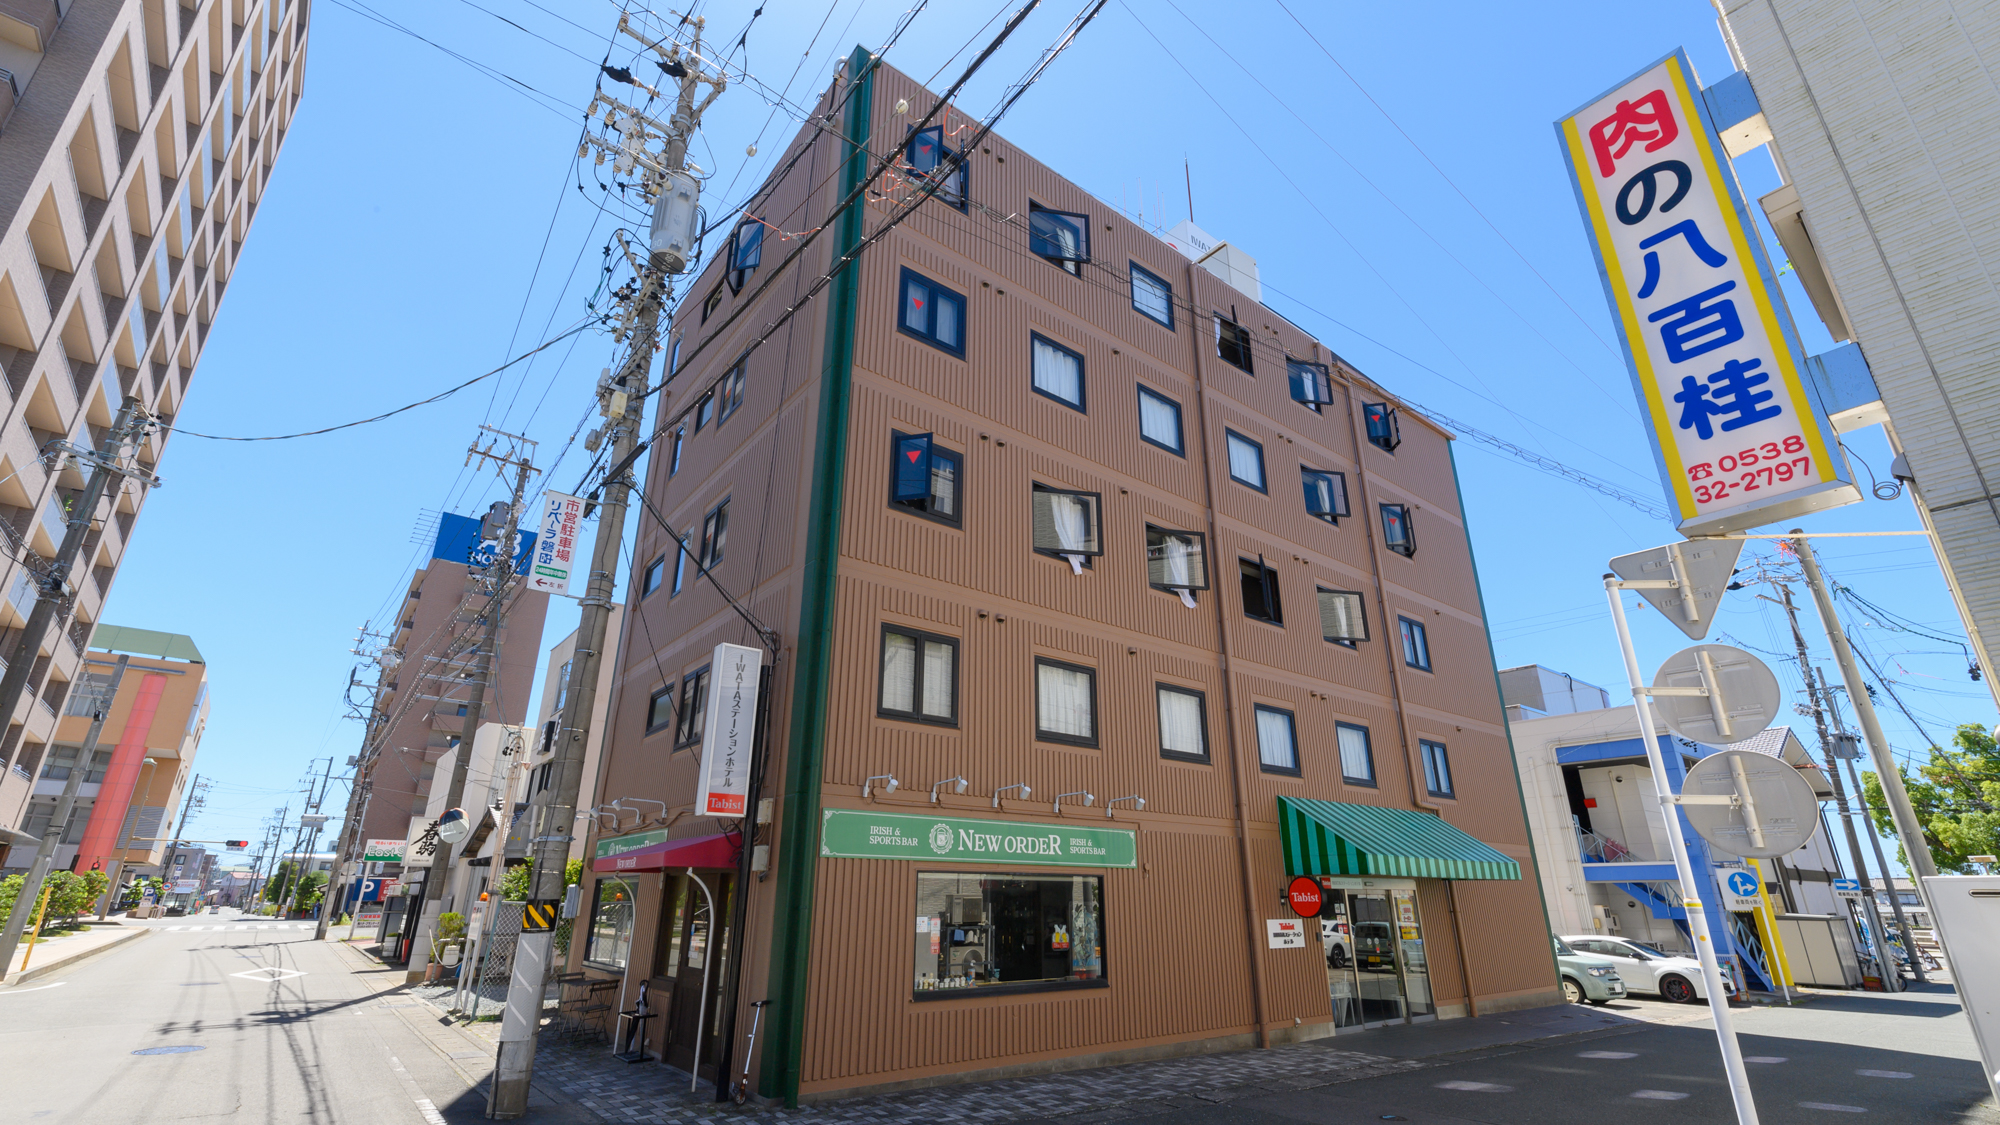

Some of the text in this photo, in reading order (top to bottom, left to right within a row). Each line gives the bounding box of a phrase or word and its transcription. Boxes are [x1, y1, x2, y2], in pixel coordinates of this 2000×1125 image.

[1589, 89, 1782, 441] 肉の八百桂
[1718, 435, 1805, 473] 0538
[1694, 456, 1810, 504] 32-2797
[538, 500, 562, 565] リベーラ磐田
[555, 499, 581, 563] 市営駐車場
[722, 653, 746, 788] IWATAステーションホテル
[709, 797, 742, 810] Tabist
[870, 825, 901, 836] IRISH &
[869, 835, 918, 847] SPORTS BAR
[958, 829, 1062, 856] NEW ORDER
[1069, 837, 1093, 847] IRISH &
[367, 845, 396, 857] East
[1069, 846, 1106, 856] SPORTS BAR
[144, 888, 154, 896] P
[362, 881, 375, 893] P
[1291, 892, 1319, 903] Tabist
